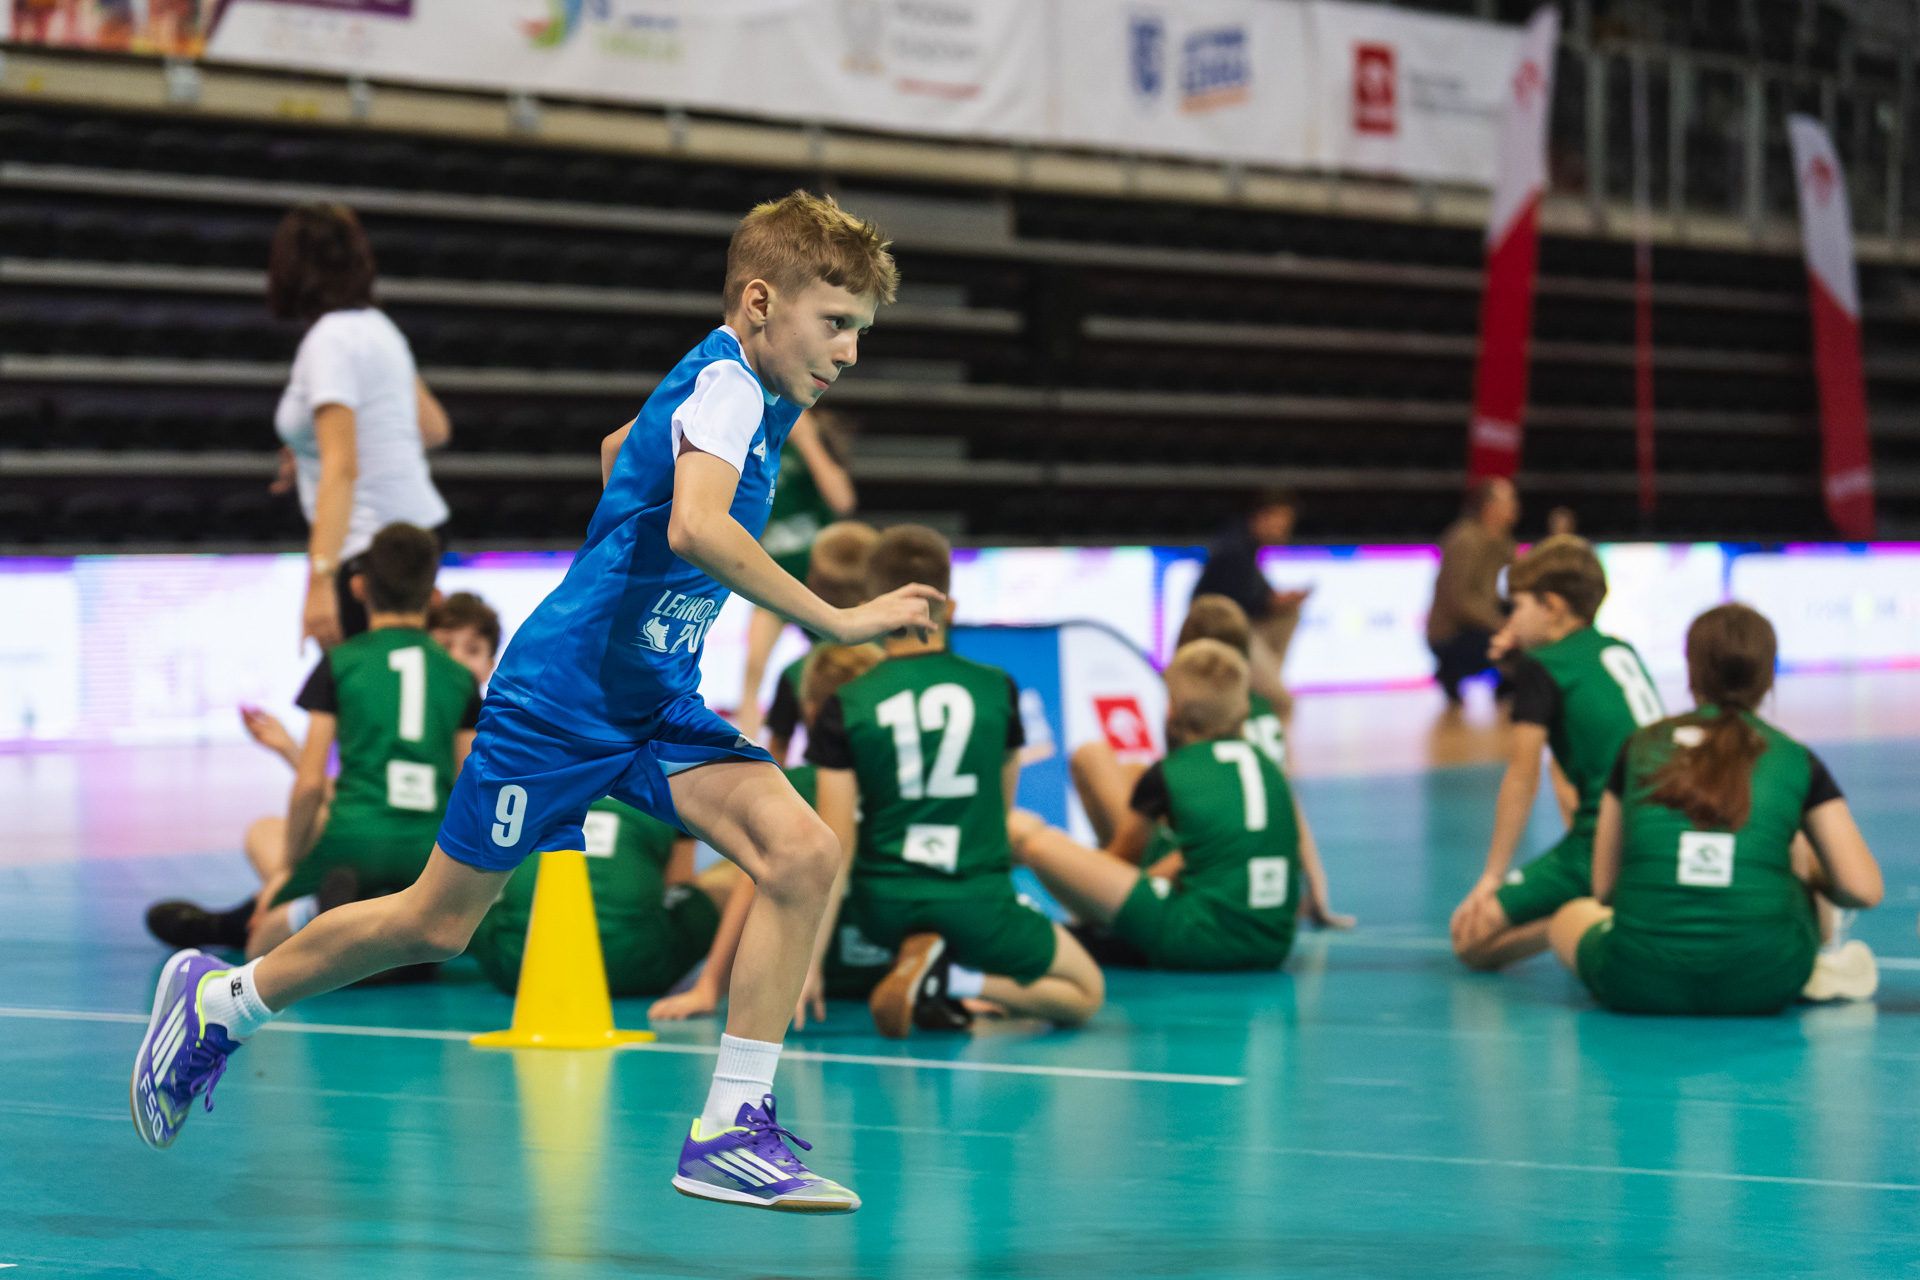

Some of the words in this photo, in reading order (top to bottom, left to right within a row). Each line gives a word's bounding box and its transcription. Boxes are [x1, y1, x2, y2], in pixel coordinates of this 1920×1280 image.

[388, 645, 425, 741] 1
[875, 683, 977, 799] 12
[491, 784, 528, 847] 9
